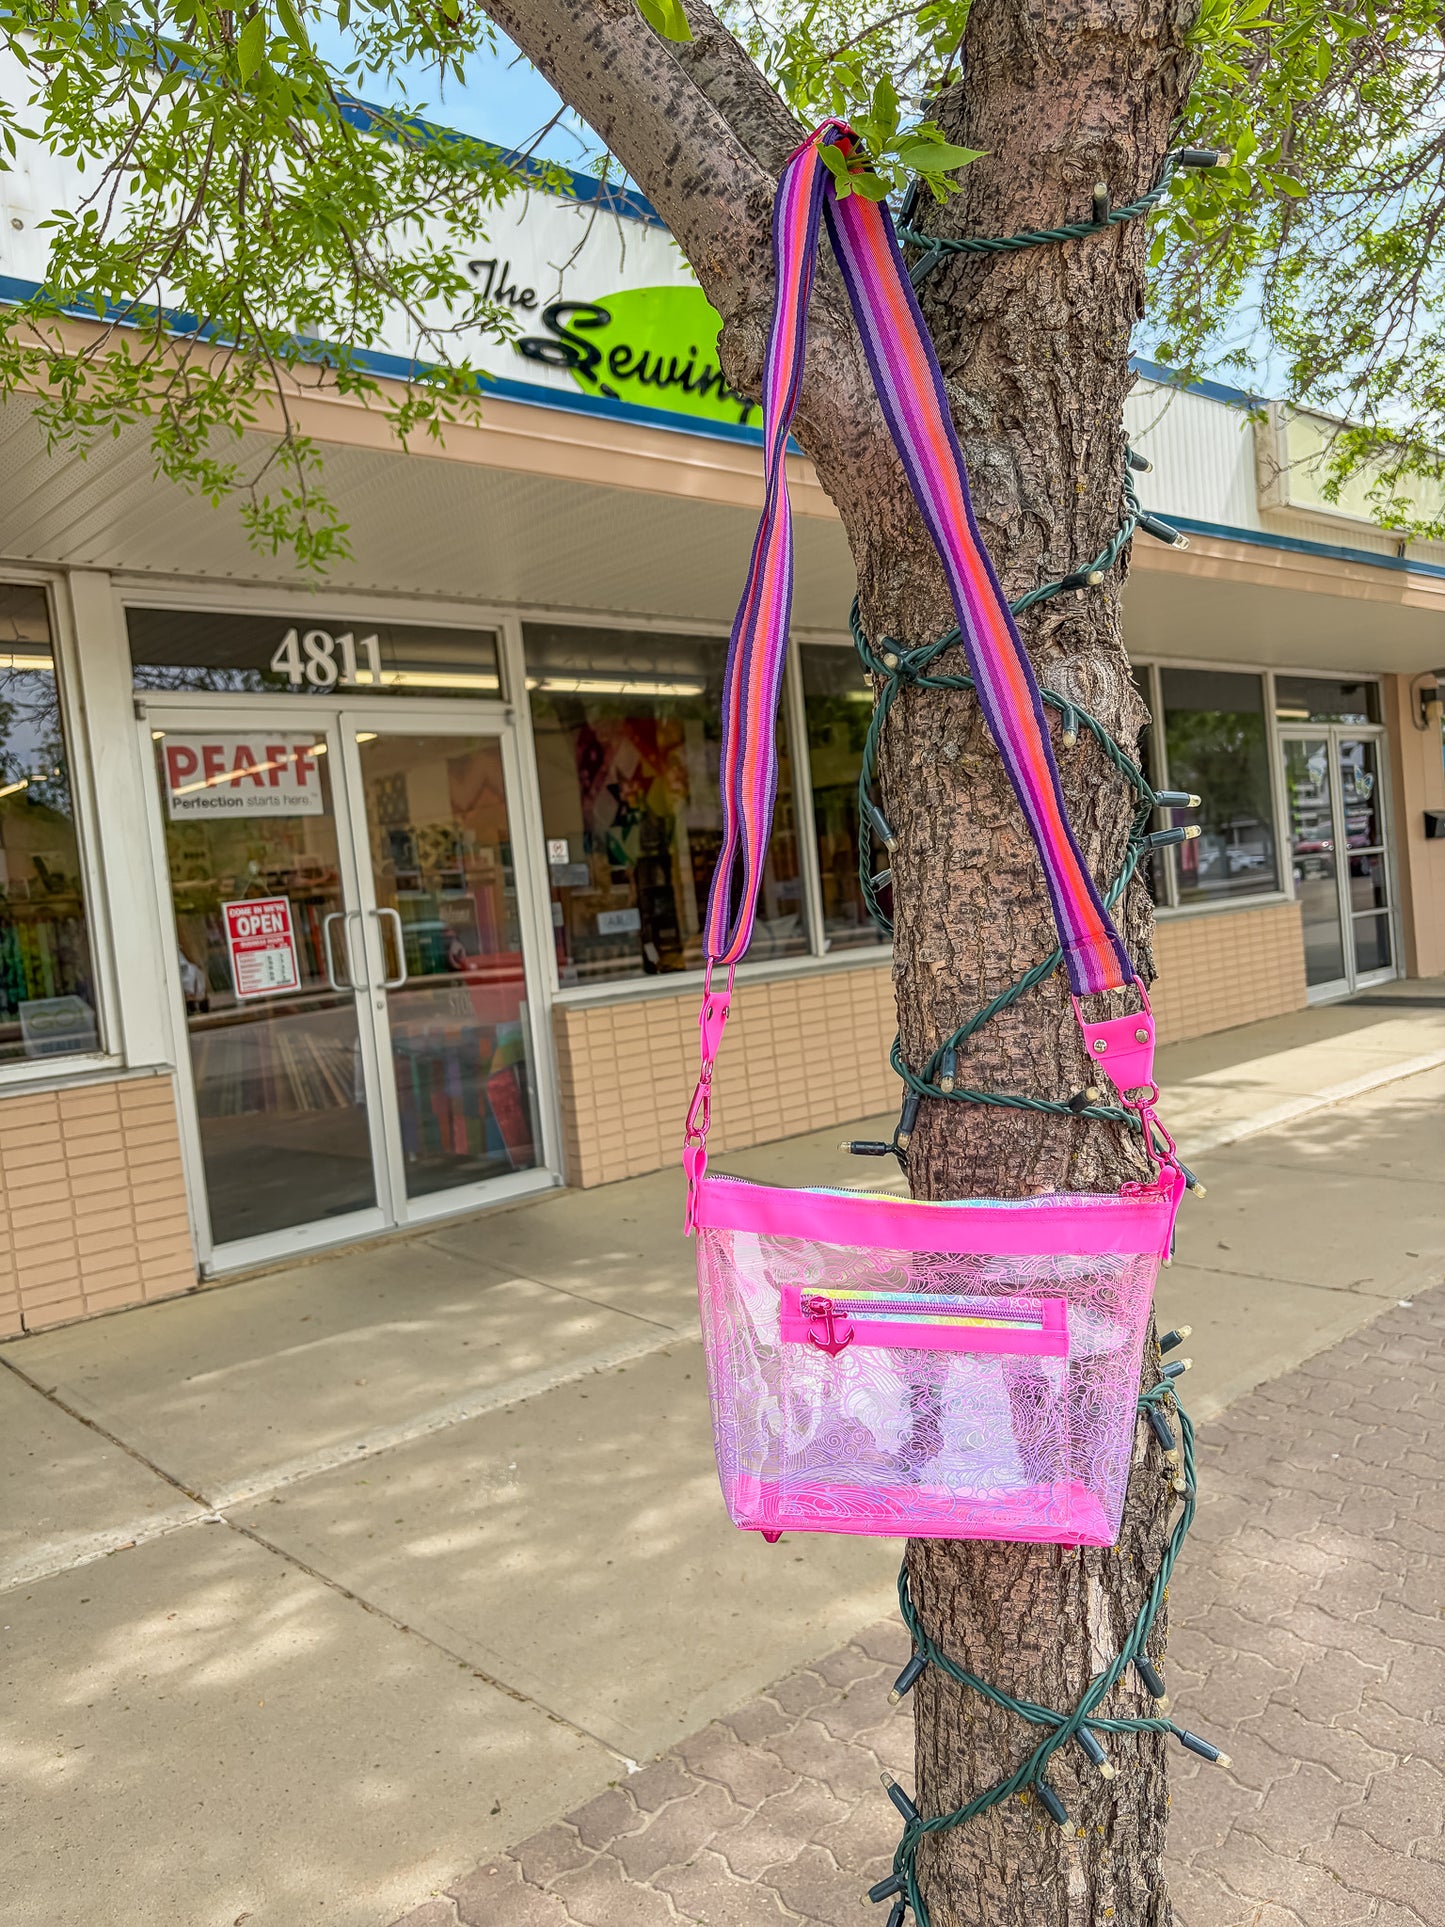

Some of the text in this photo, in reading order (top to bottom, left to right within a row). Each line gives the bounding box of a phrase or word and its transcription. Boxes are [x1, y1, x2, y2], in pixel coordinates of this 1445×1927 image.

[468, 258, 539, 309] The
[269, 628, 390, 688] 4811
[166, 745, 316, 790] PFAFF
[172, 795, 244, 809] Perfection
[247, 794, 281, 807] starts
[236, 912, 285, 937] OPEN
